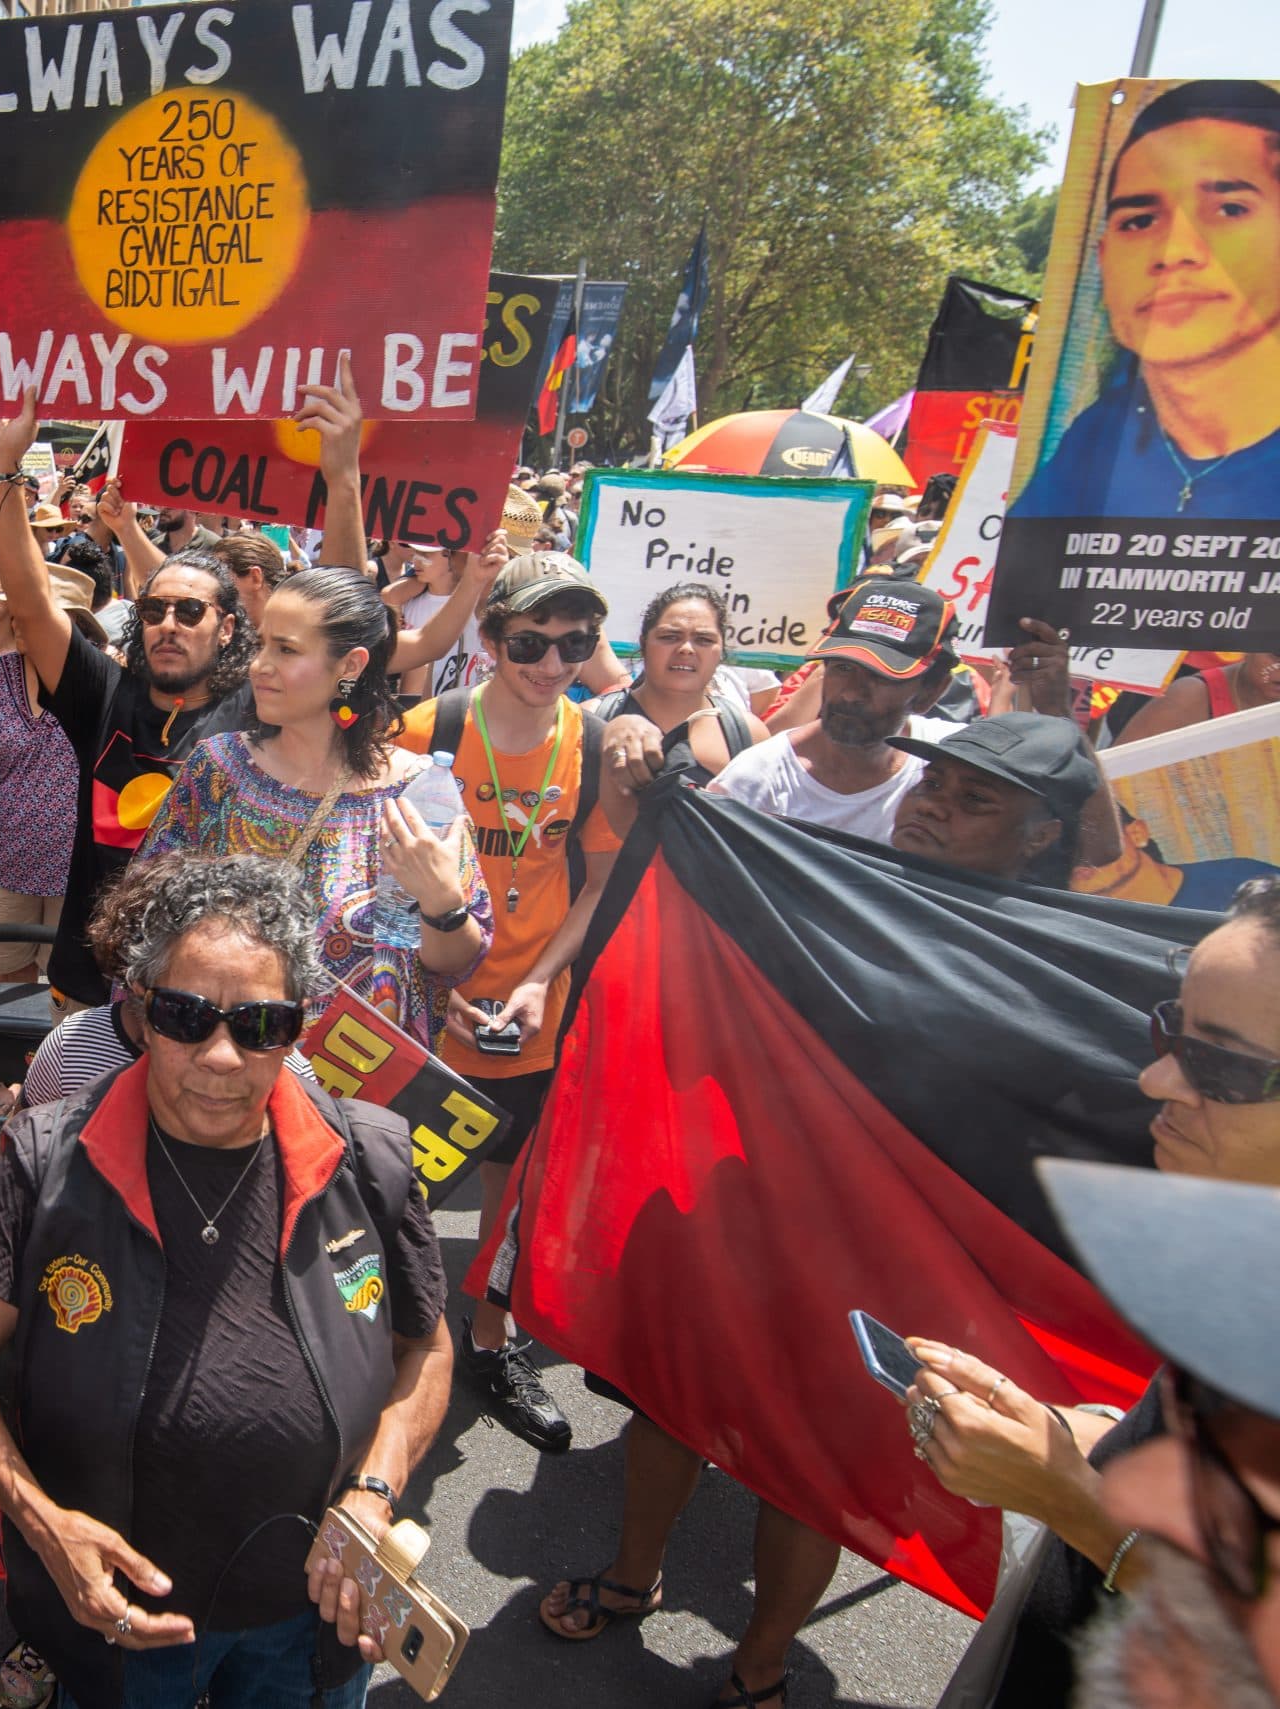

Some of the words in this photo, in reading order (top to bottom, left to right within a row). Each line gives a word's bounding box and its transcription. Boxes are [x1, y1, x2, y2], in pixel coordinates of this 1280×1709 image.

[292, 0, 491, 94] WAS
[158, 98, 236, 142] 250
[118, 144, 205, 182] YEARS
[220, 142, 258, 176] OF
[97, 182, 275, 226] RESISTANCE
[119, 222, 263, 267] GWEAGAL
[105, 267, 241, 308] BIDJIGAL
[380, 333, 478, 412] BE
[159, 438, 279, 516] COAL
[620, 499, 666, 528] No
[645, 538, 735, 577] Pride
[1064, 532, 1122, 555] DIED
[1127, 533, 1167, 557] 20
[1171, 534, 1247, 558] SEPT
[1059, 567, 1082, 590] IN
[1085, 567, 1246, 593] TAMWORTH
[1091, 602, 1127, 625] 22
[1130, 608, 1204, 631] years
[1209, 607, 1252, 630] old
